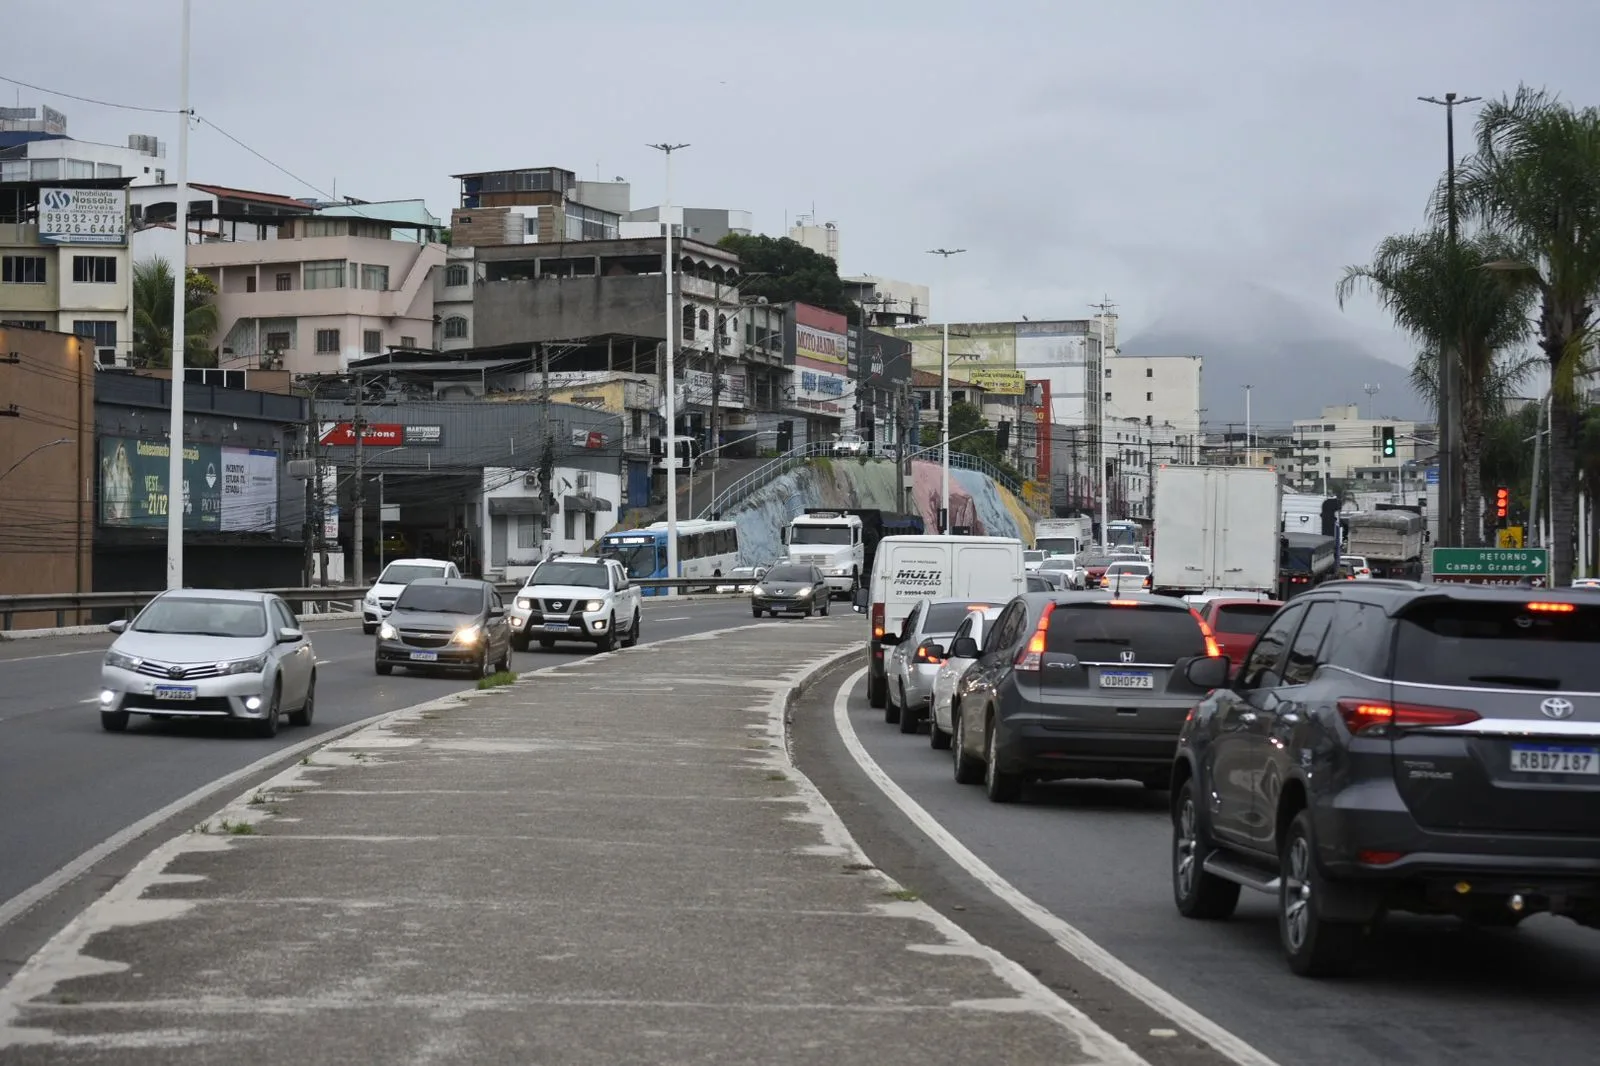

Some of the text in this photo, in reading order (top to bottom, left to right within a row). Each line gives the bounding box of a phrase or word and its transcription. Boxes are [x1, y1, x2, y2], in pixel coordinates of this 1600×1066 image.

[72, 196, 118, 205] Nossolar
[47, 213, 124, 224] 99932-9711
[46, 223, 124, 234] 3226-6444
[797, 330, 816, 352] MOTO
[148, 492, 168, 515] 21/12
[1479, 552, 1528, 561] RETORNO
[1446, 562, 1528, 571] Campo Grande
[896, 569, 942, 580] MULTI
[893, 579, 942, 587] PROTEÇÃO
[1481, 578, 1522, 587] Andrad
